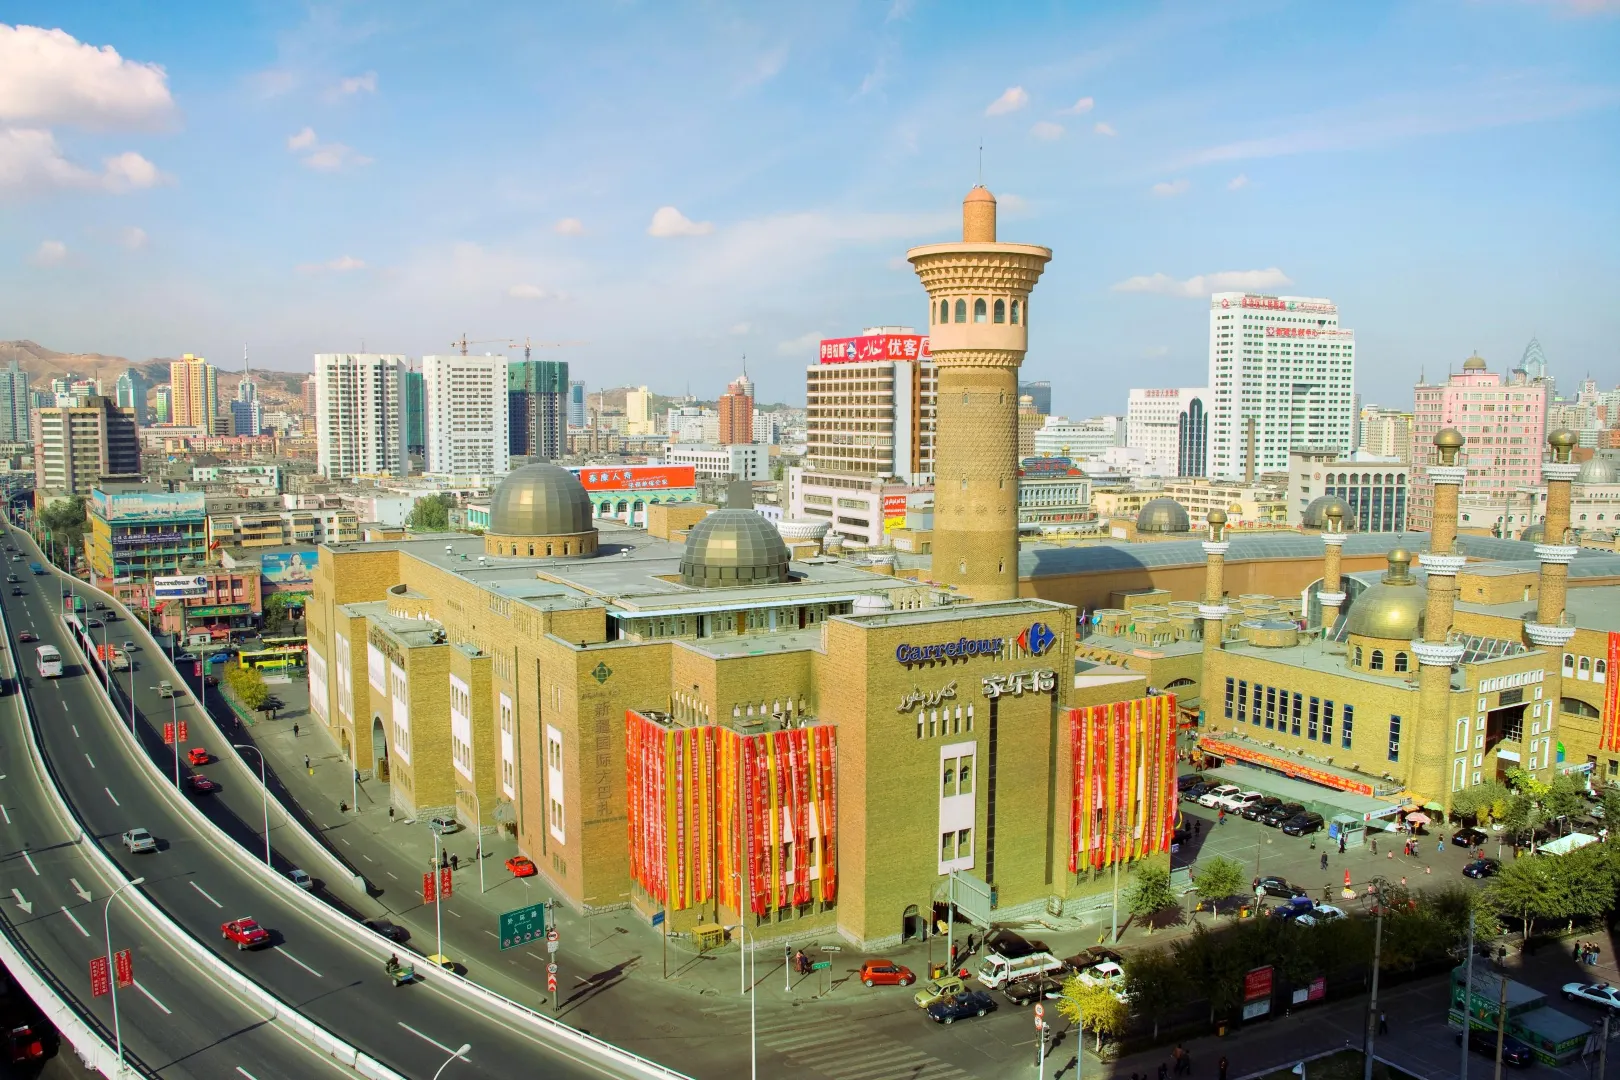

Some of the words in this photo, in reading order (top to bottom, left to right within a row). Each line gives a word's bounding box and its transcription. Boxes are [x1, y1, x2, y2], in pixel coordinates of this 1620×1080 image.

[887, 338, 918, 357] 优客
[896, 637, 1002, 663] Carrefour
[982, 668, 1054, 698] 家乐福
[513, 924, 532, 934] 入口
